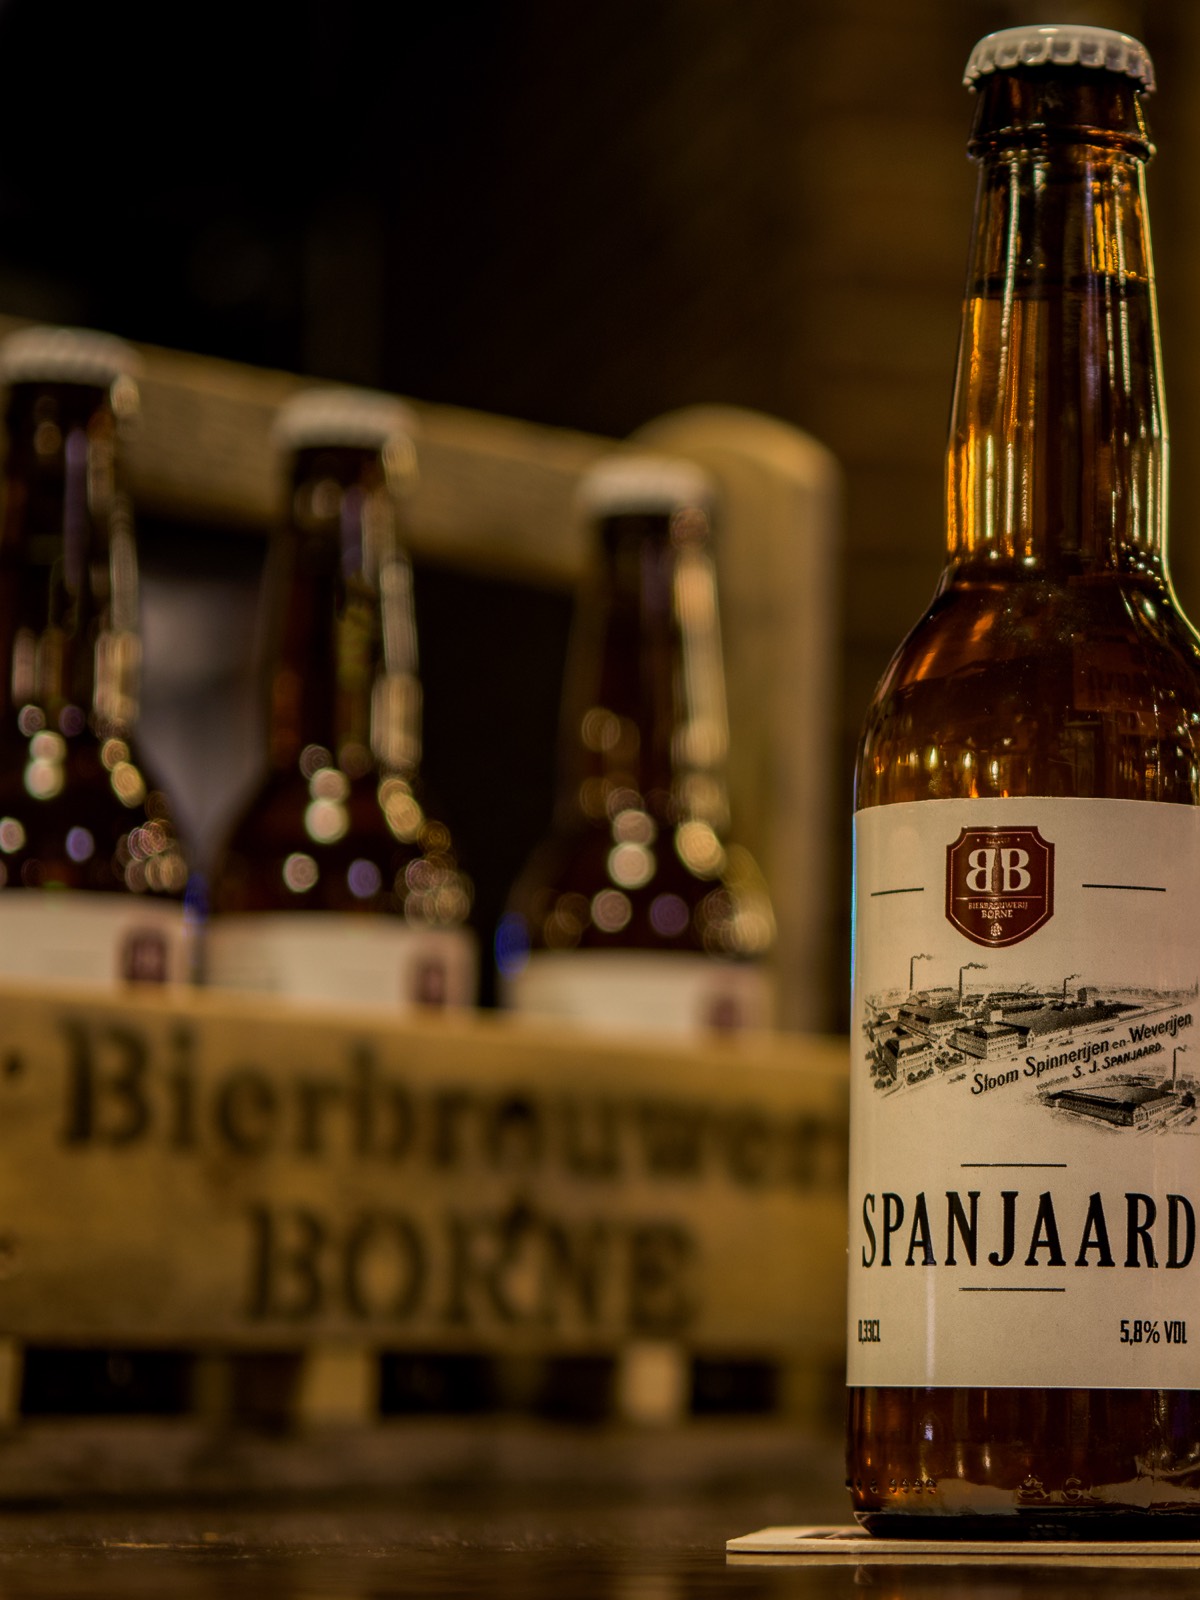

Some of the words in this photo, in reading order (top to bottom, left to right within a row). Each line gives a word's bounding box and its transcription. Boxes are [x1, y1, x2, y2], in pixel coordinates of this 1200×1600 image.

[981, 909, 1013, 919] BORNE
[971, 1069, 1019, 1095] Stoom
[1022, 1039, 1110, 1078] Spinnerijen
[60, 1018, 849, 1190] Bierbrouwer
[861, 1190, 1197, 1269] SPANJAARD
[240, 1205, 698, 1332] BORNE
[1120, 1319, 1160, 1346] 5,8%
[1163, 1320, 1188, 1344] VOL
